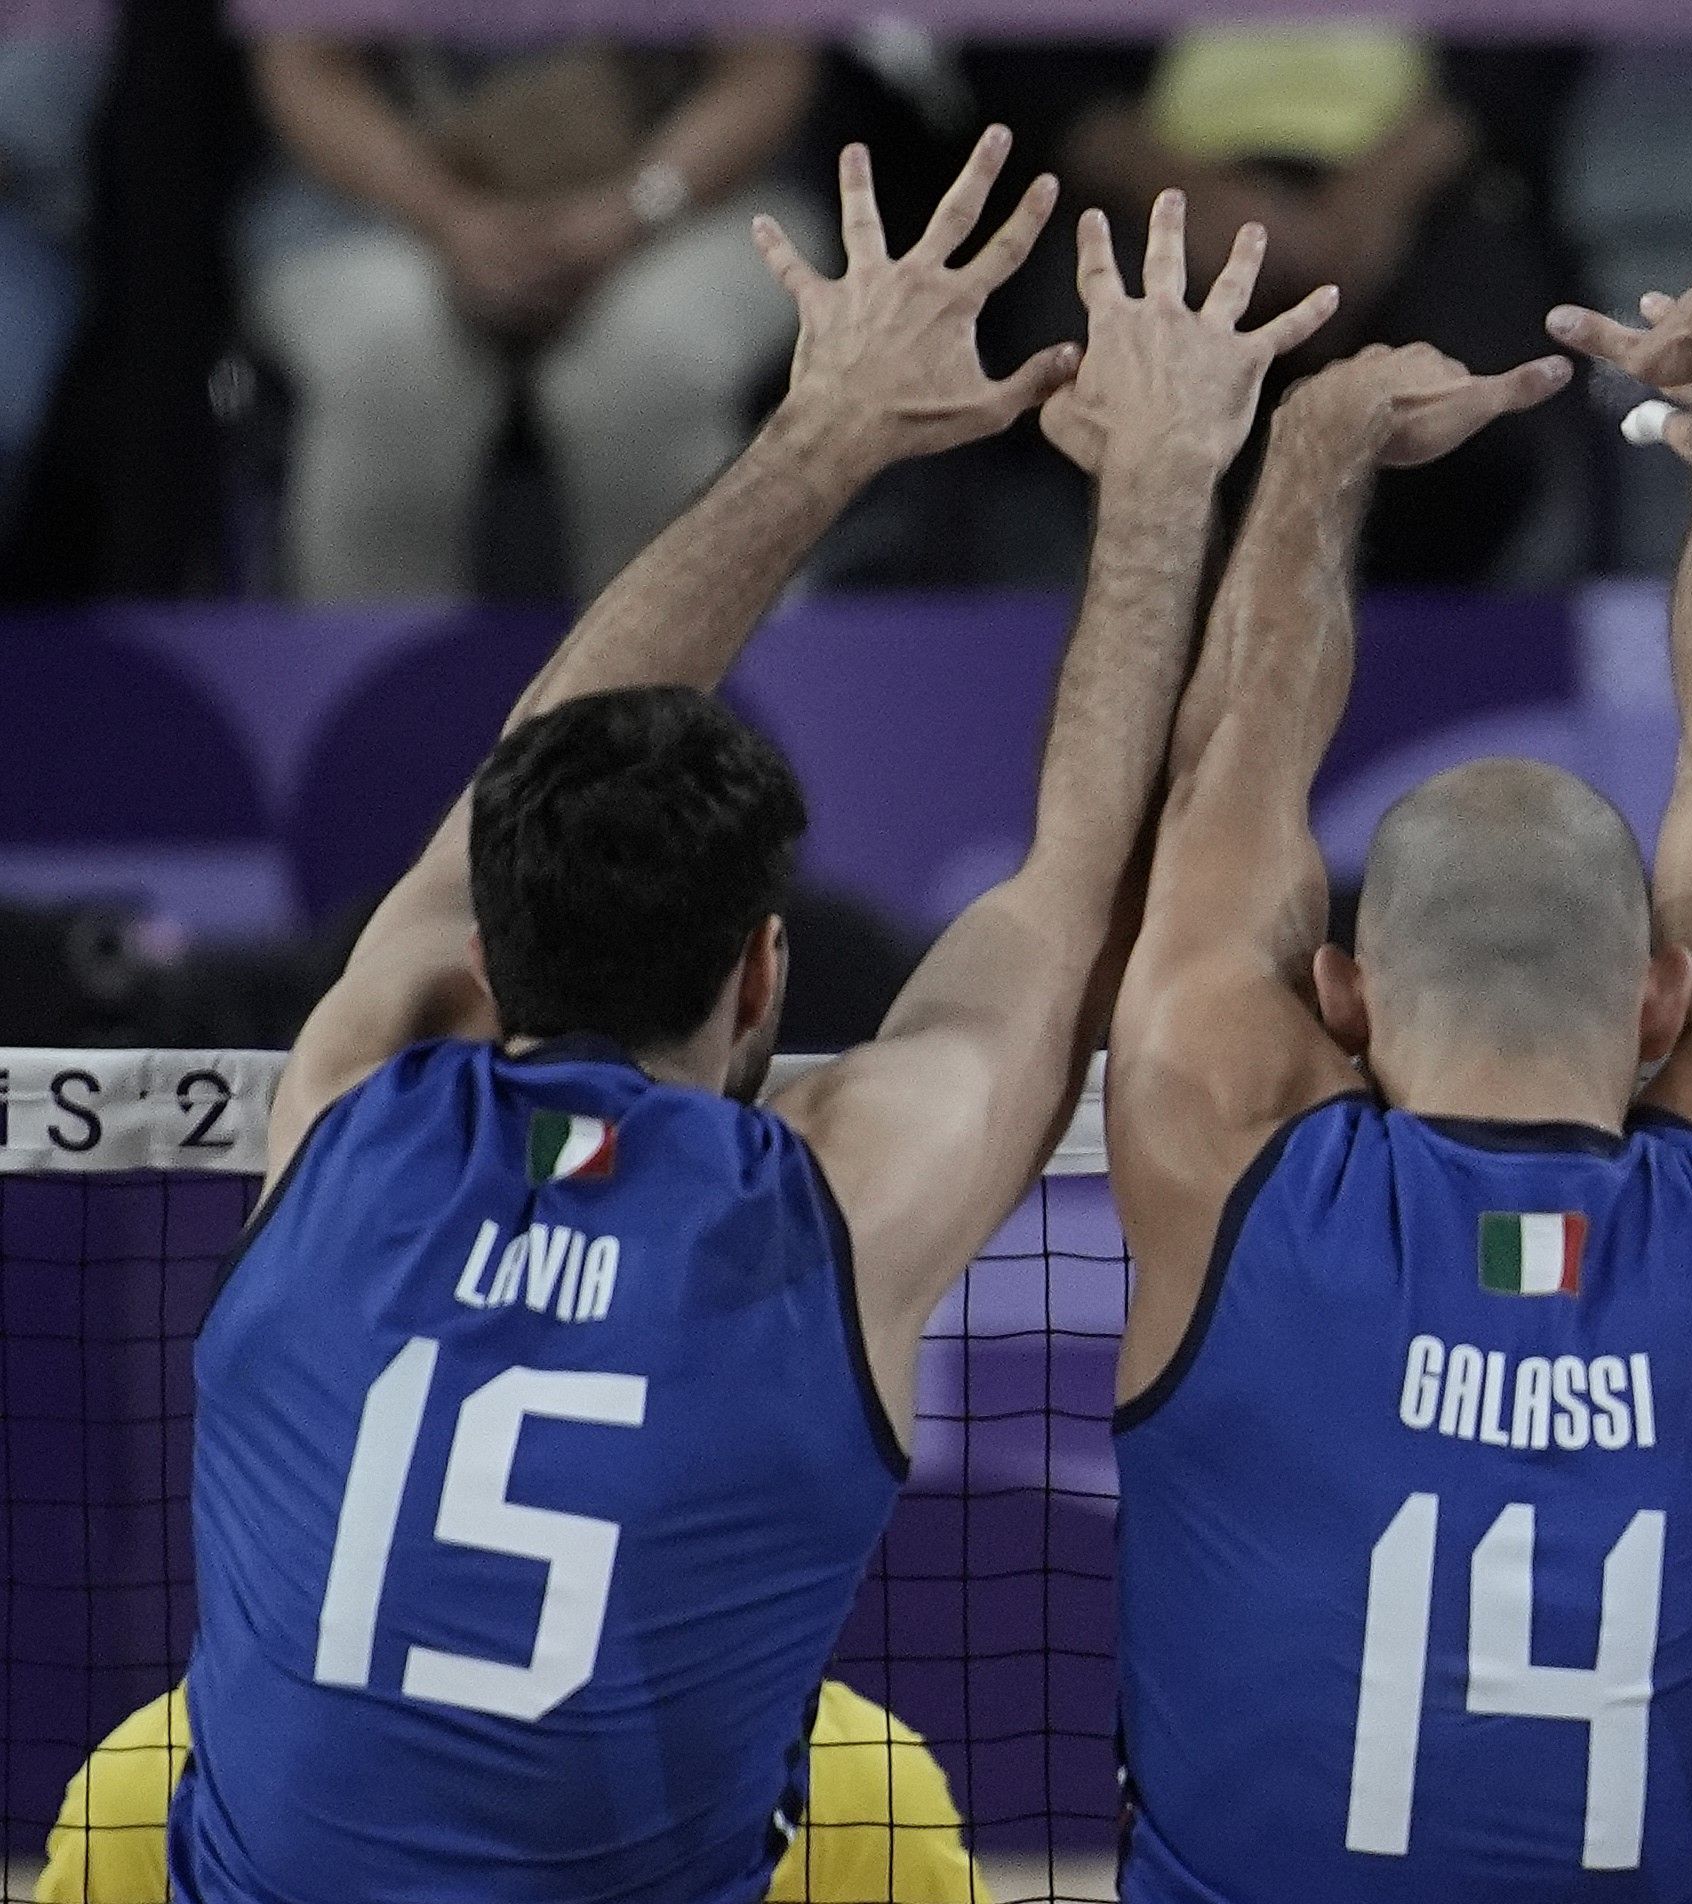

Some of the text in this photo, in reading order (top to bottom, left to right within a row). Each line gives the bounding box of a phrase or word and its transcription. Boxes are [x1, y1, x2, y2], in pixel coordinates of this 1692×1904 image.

[456, 1220, 620, 1323] LAVIA
[1401, 1333, 1656, 1450] GALASSI
[313, 1335, 648, 1723] 15
[1345, 1492, 1666, 1871] 14
